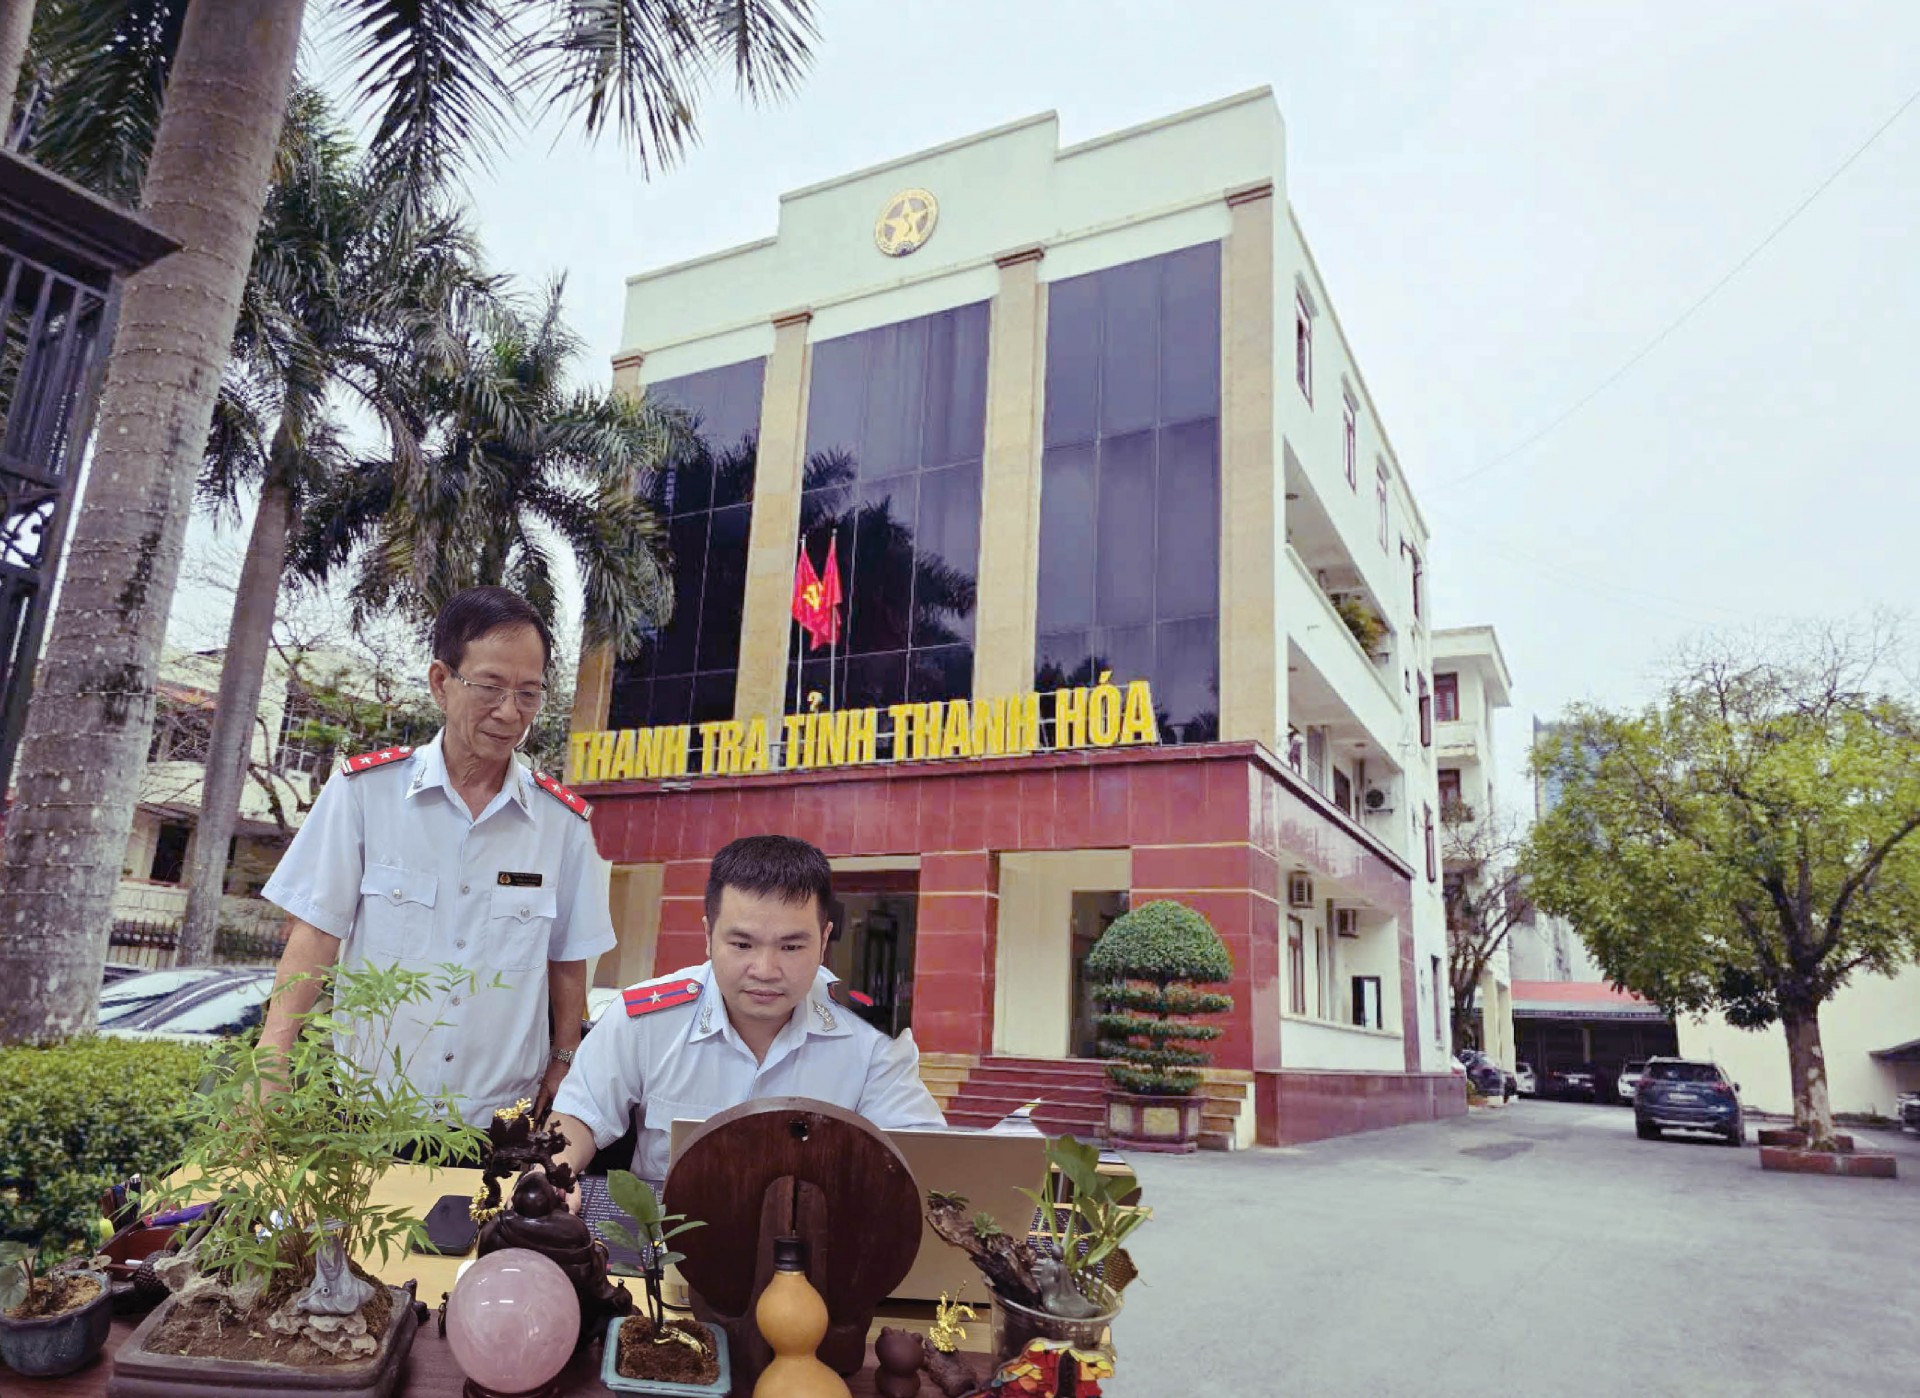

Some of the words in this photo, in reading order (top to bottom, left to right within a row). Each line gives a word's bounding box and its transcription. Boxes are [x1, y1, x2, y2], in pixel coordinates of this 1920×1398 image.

[571, 725, 688, 783] THANH
[700, 716, 769, 775] TRA
[784, 691, 876, 769] TỈNH
[889, 691, 1040, 761] THANH
[1055, 671, 1158, 749] HÓA
